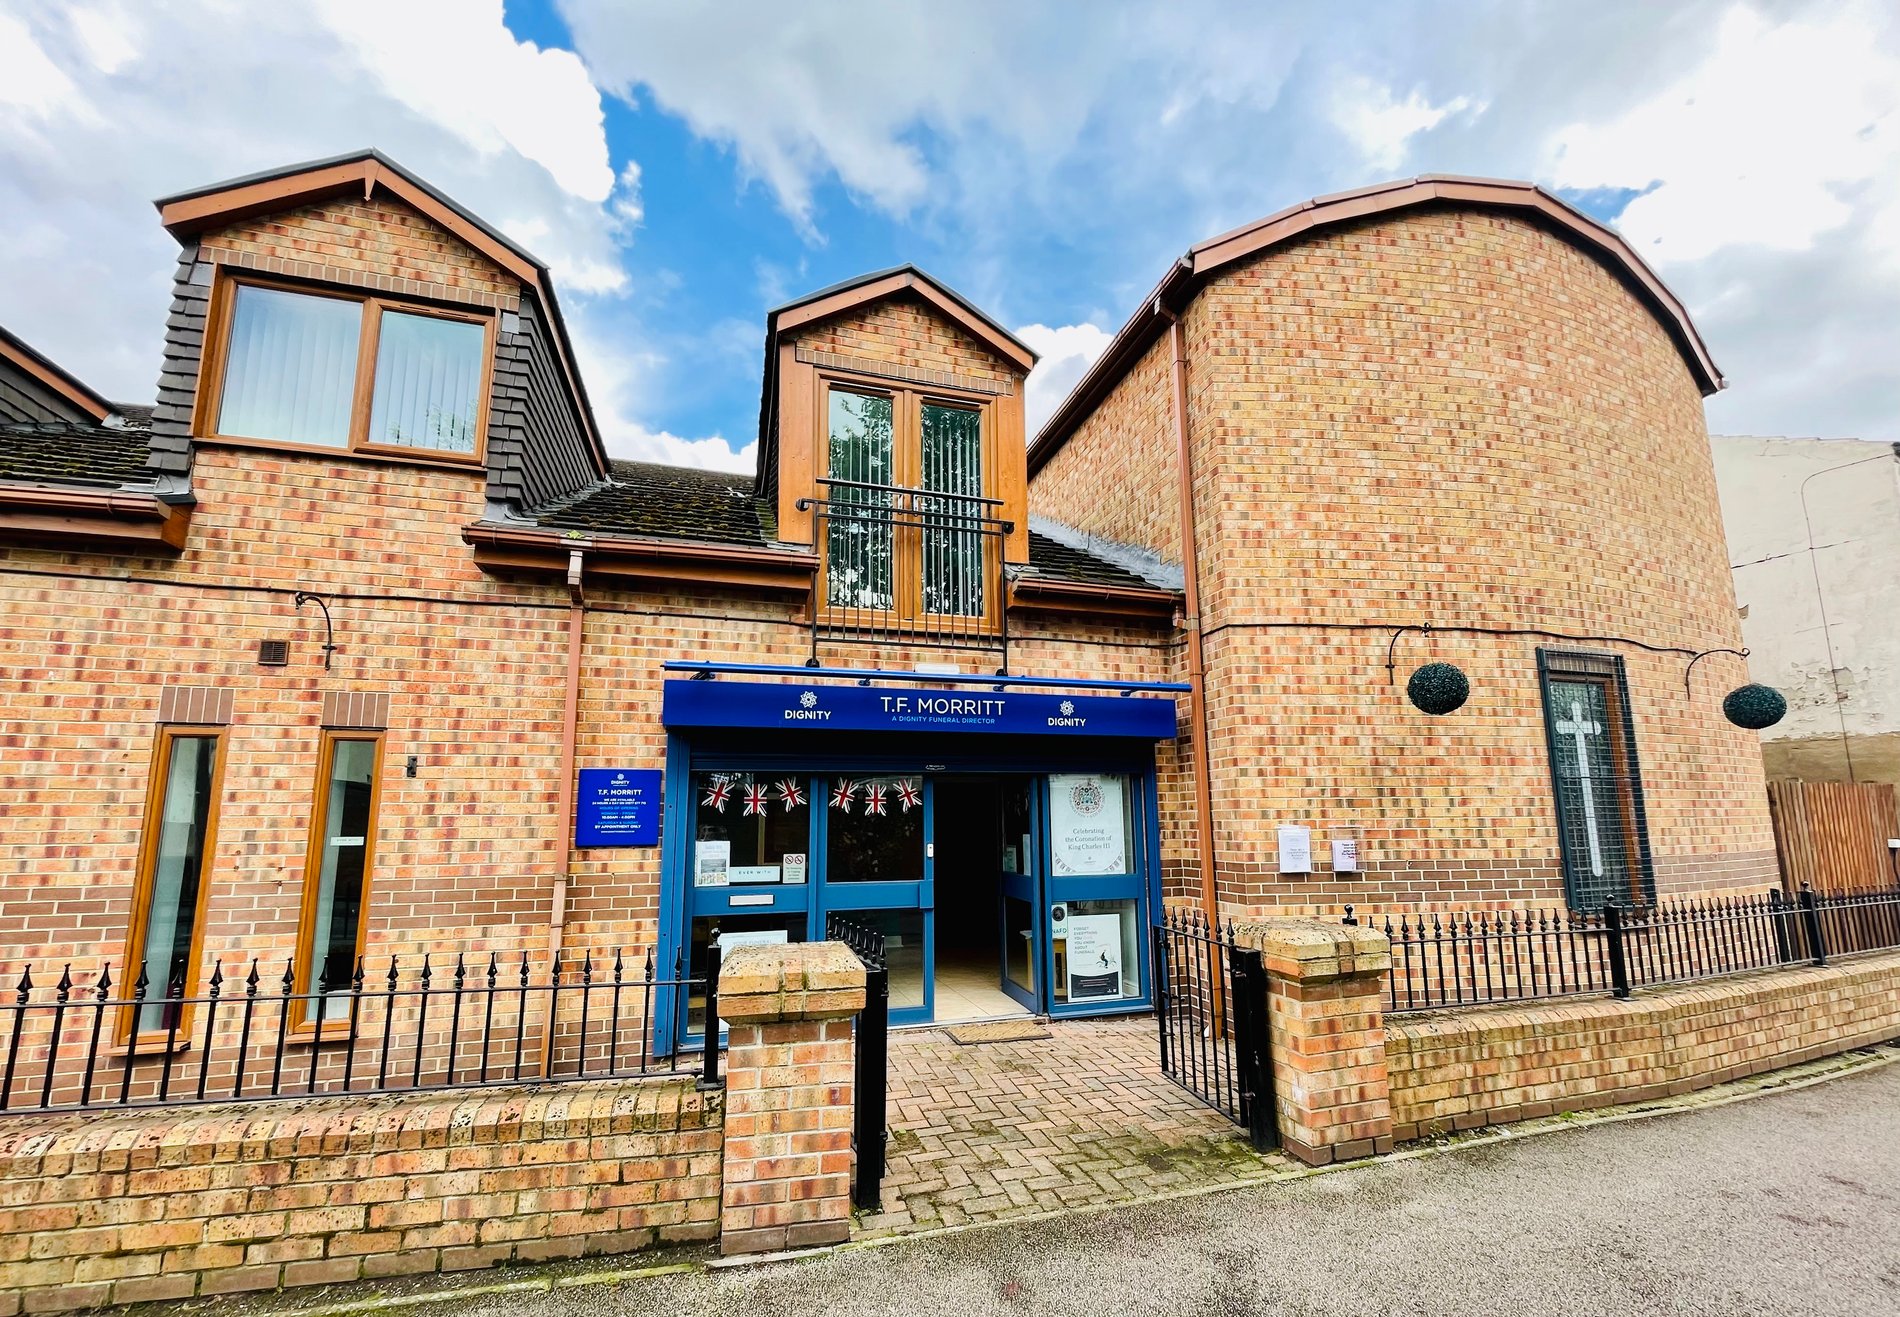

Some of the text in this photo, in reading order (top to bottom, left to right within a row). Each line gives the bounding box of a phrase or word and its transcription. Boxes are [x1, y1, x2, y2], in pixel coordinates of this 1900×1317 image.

[880, 696, 1006, 716] T.F. MORRITT
[784, 709, 832, 720] DIGNITY
[1048, 717, 1087, 727] DIGNITY
